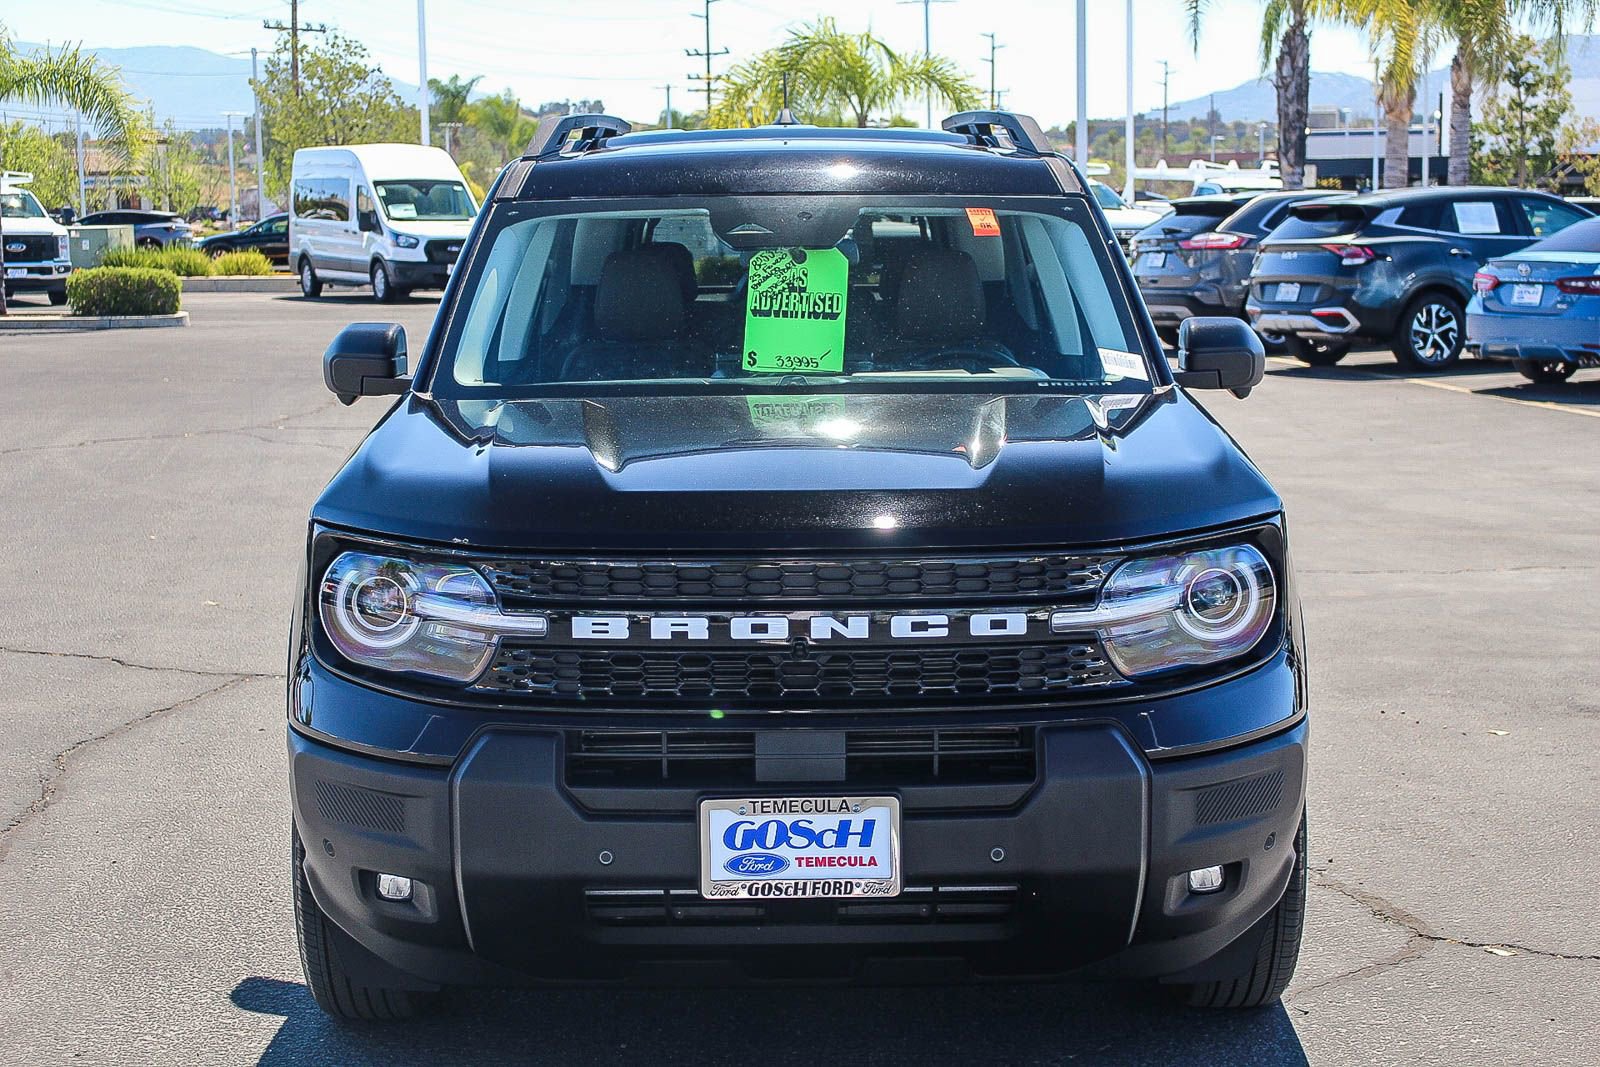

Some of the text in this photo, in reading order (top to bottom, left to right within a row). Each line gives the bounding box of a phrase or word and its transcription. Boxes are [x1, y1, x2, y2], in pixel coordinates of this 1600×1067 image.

[790, 267, 808, 292] AS
[751, 290, 843, 320] ADVERTISED
[747, 350, 757, 367] $
[571, 613, 1027, 640] BRONCO
[749, 799, 851, 814] TEMECULA
[738, 856, 774, 872] Ford
[795, 856, 878, 867] TEMECULA
[710, 883, 740, 897] Ford
[811, 881, 854, 896] FORD
[862, 881, 894, 895] Ford
